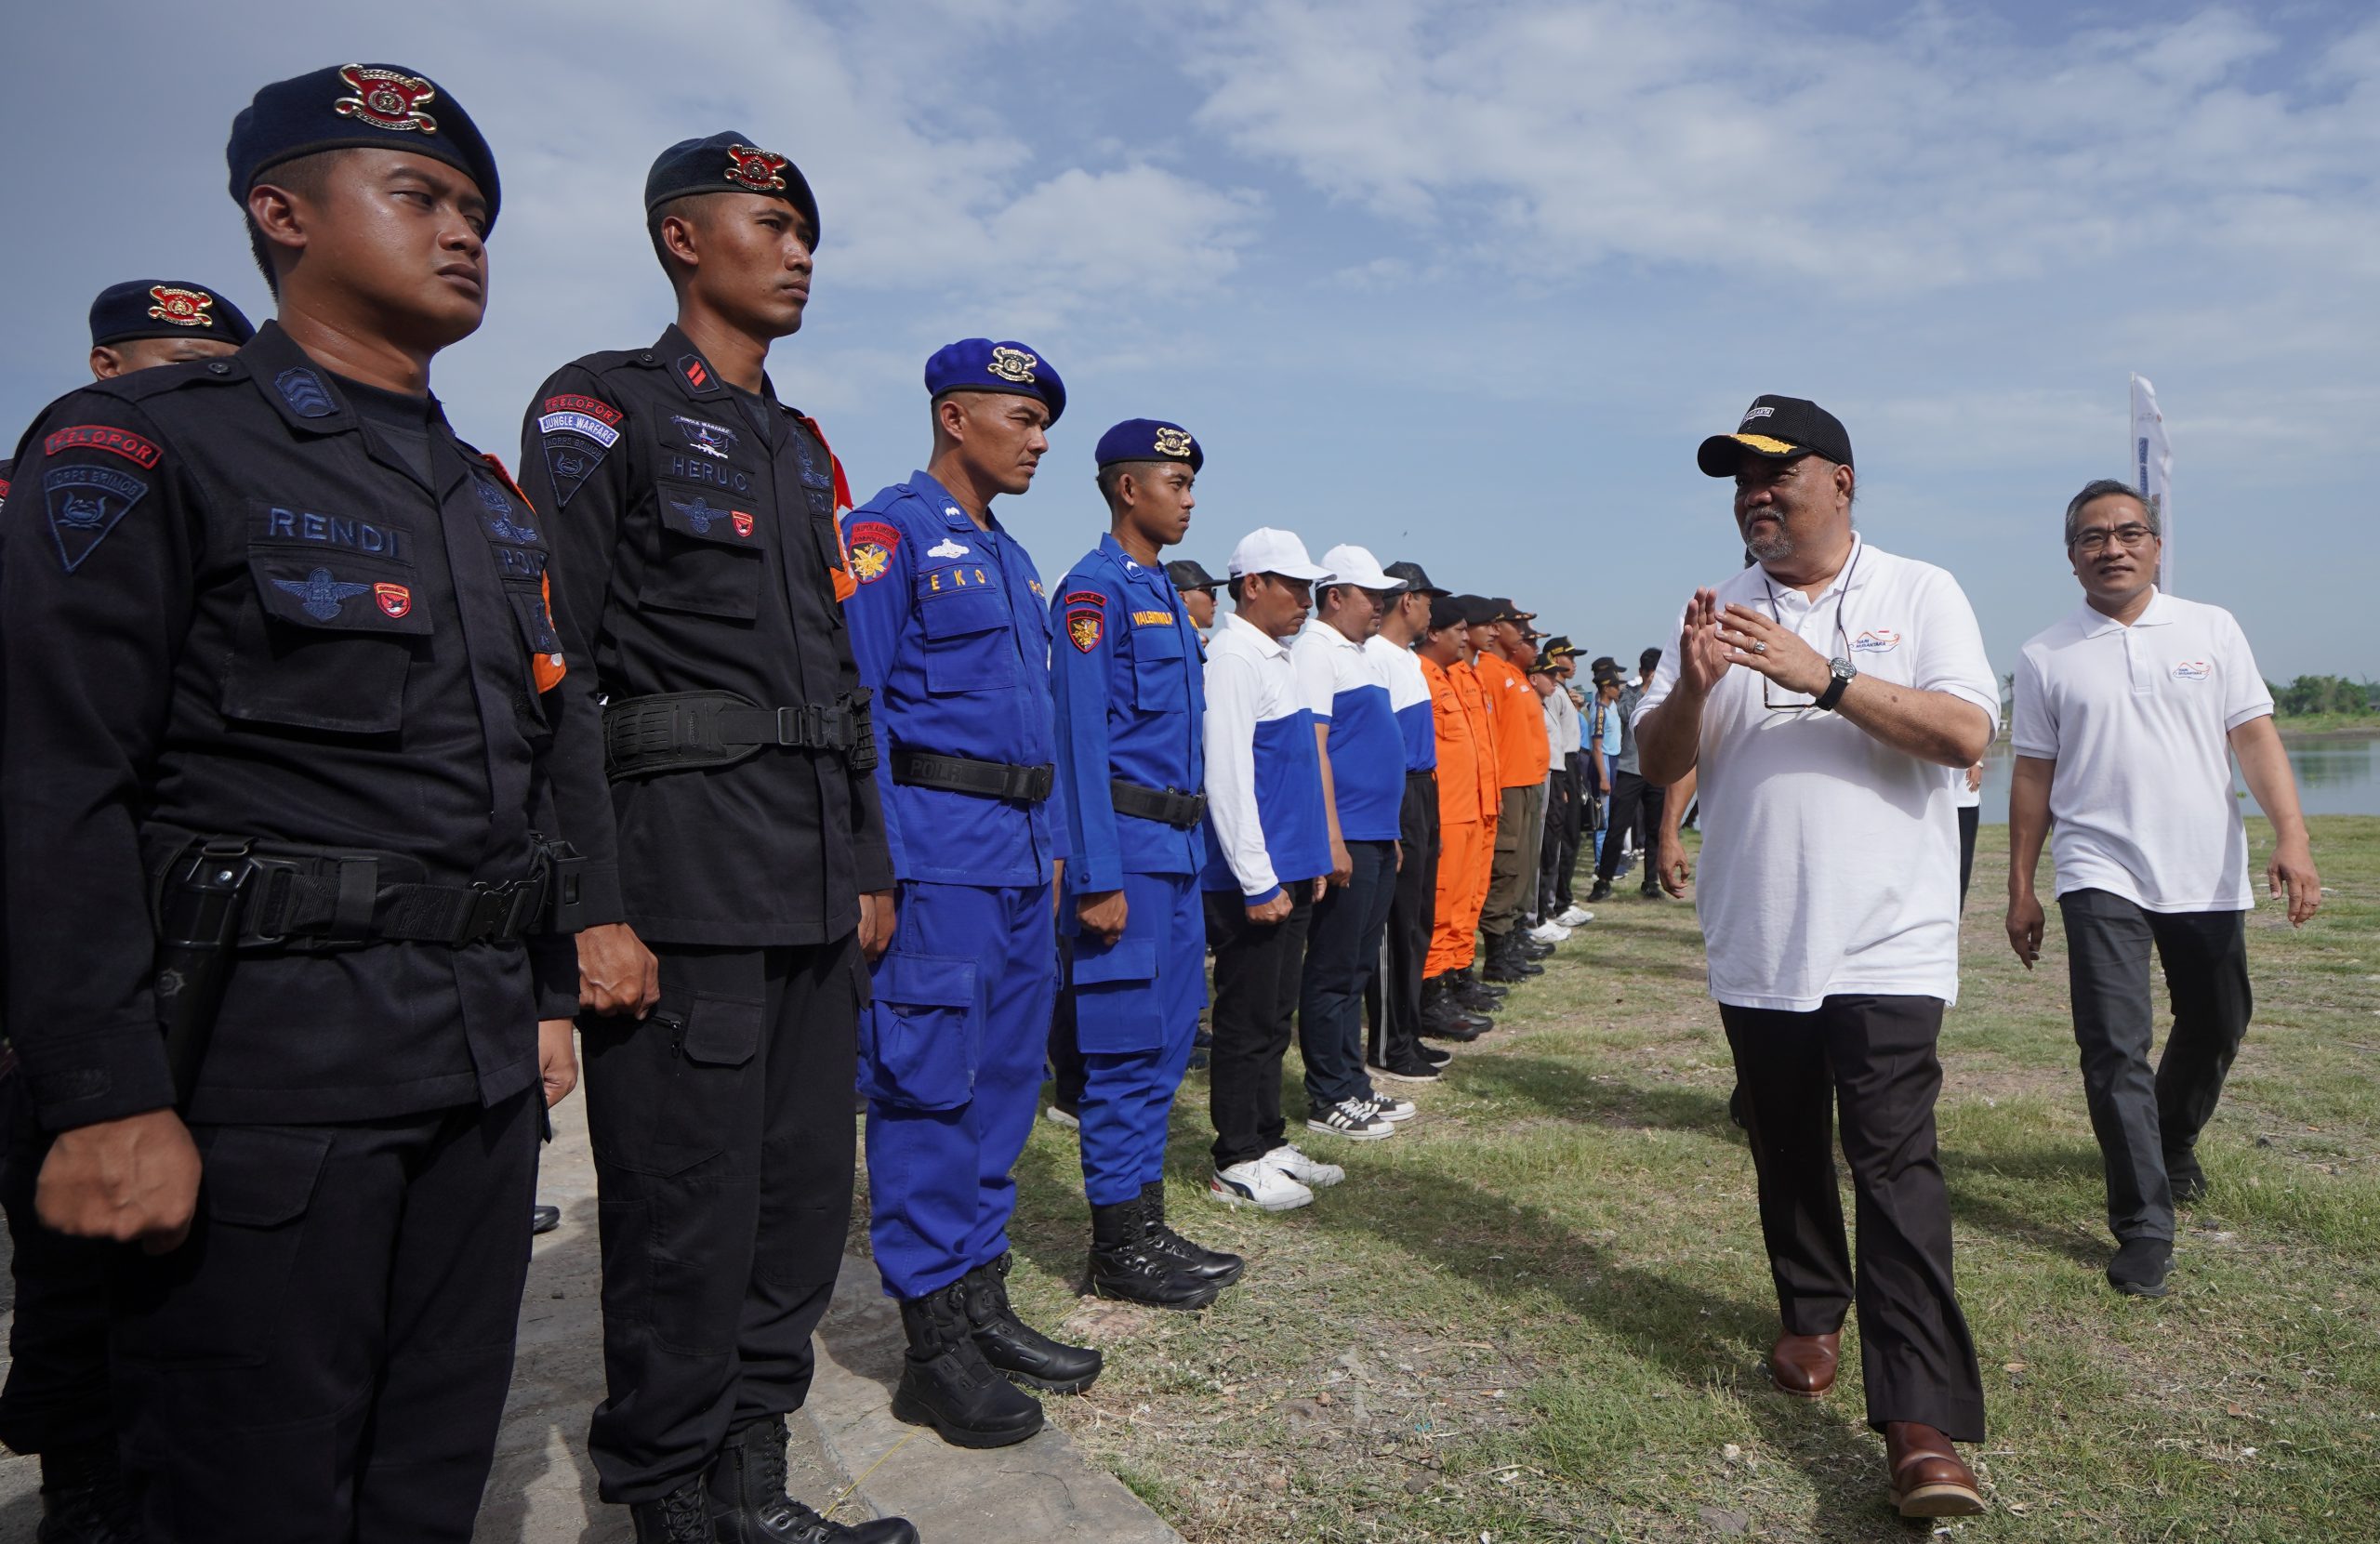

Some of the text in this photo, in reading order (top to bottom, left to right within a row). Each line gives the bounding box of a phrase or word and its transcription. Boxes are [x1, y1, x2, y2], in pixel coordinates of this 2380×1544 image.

[550, 397, 615, 420] PELOPOR
[545, 416, 614, 442] JUNGLE WARFARE
[701, 421, 730, 434] WARFARE
[53, 430, 153, 460] PELOPOR
[269, 507, 400, 558] RENDI
